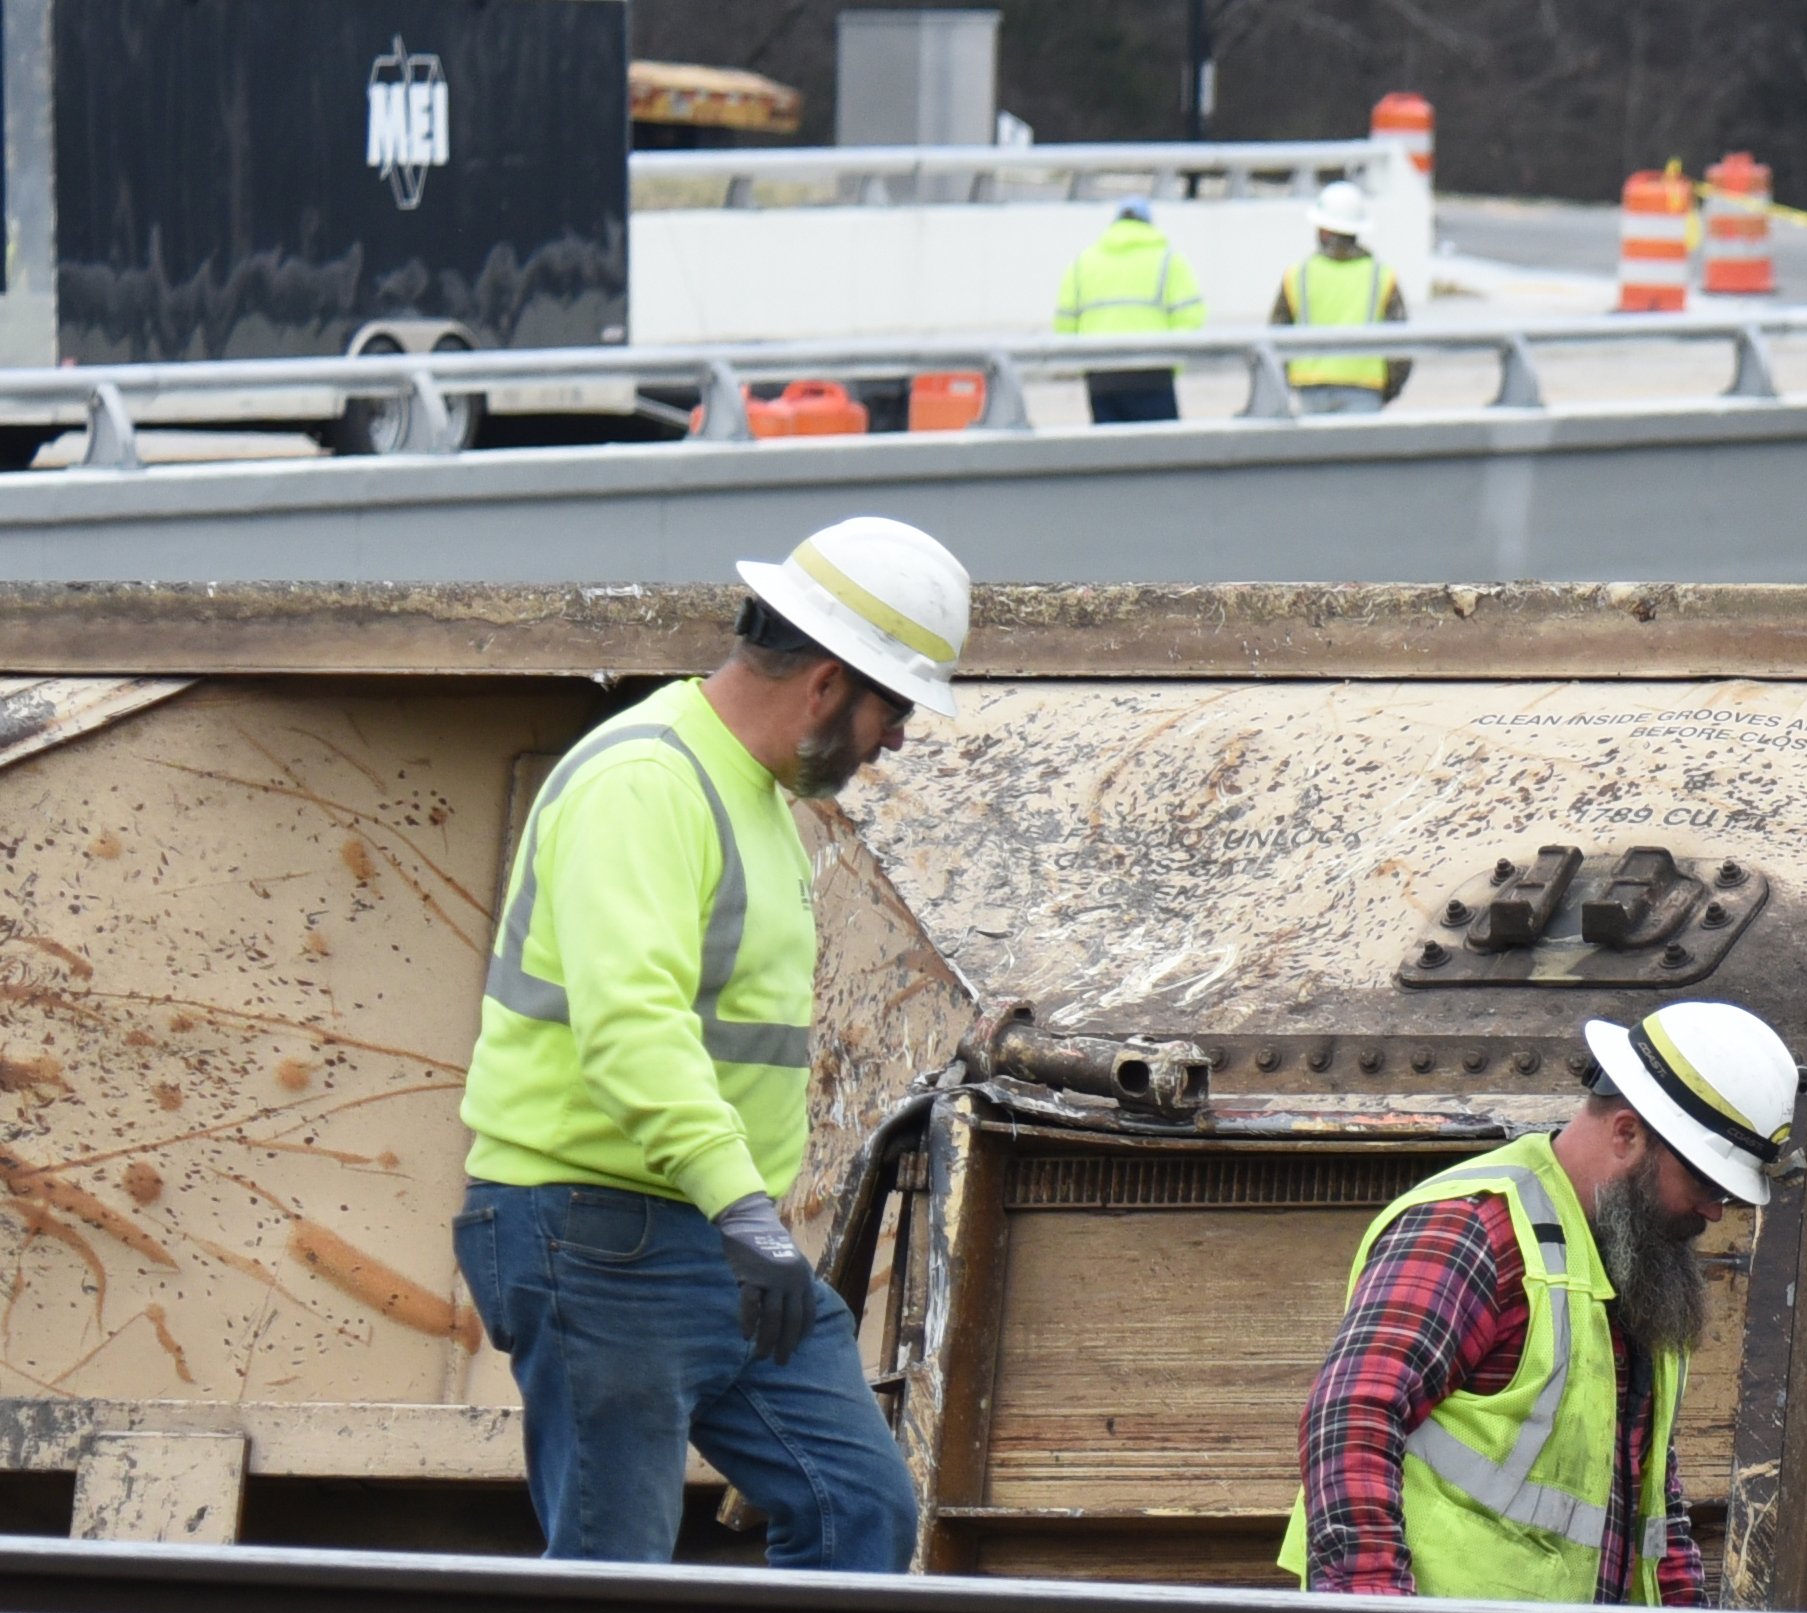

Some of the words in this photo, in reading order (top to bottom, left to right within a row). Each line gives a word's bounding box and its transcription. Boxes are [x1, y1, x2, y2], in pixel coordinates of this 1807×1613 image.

[367, 81, 449, 167] MEI
[1477, 713, 1564, 727] CLEAN
[1566, 712, 1652, 726] INSIDE
[1656, 709, 1783, 729] GROOVES
[1629, 726, 1734, 740] BEFORE
[1222, 826, 1362, 851] UNLOCK
